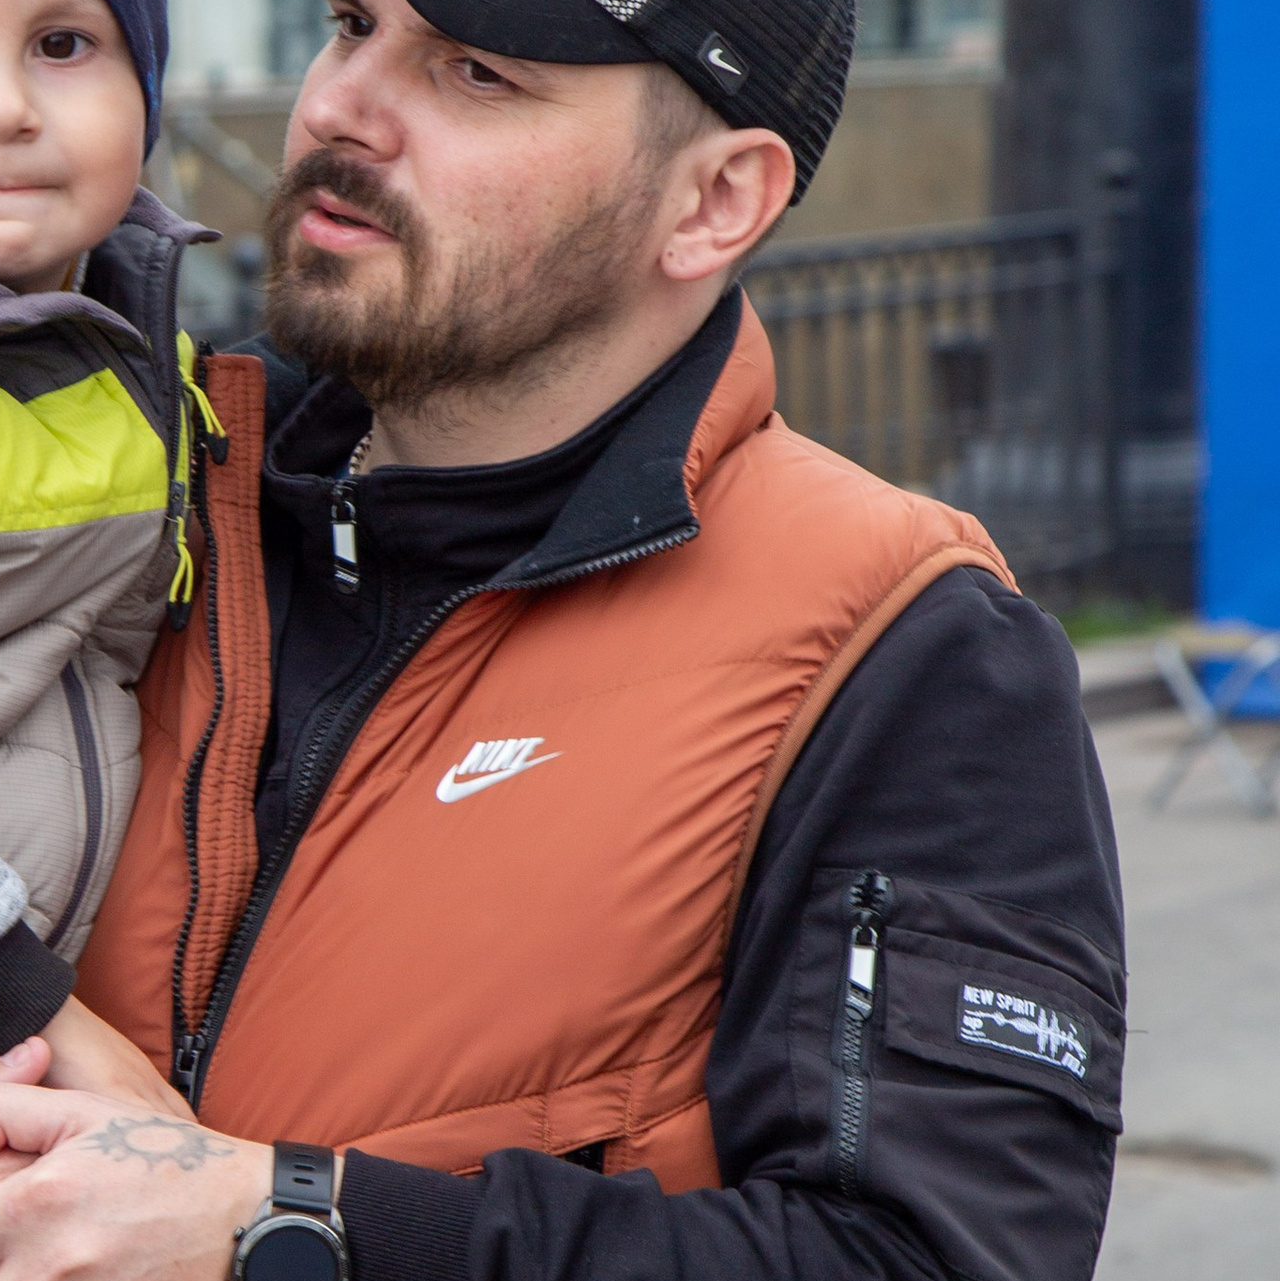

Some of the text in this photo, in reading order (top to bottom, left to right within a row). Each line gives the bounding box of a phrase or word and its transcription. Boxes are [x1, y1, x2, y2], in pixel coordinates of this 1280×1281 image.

[456, 736, 546, 775] NIKE
[963, 985, 1037, 1018] NEW SPIRIT
